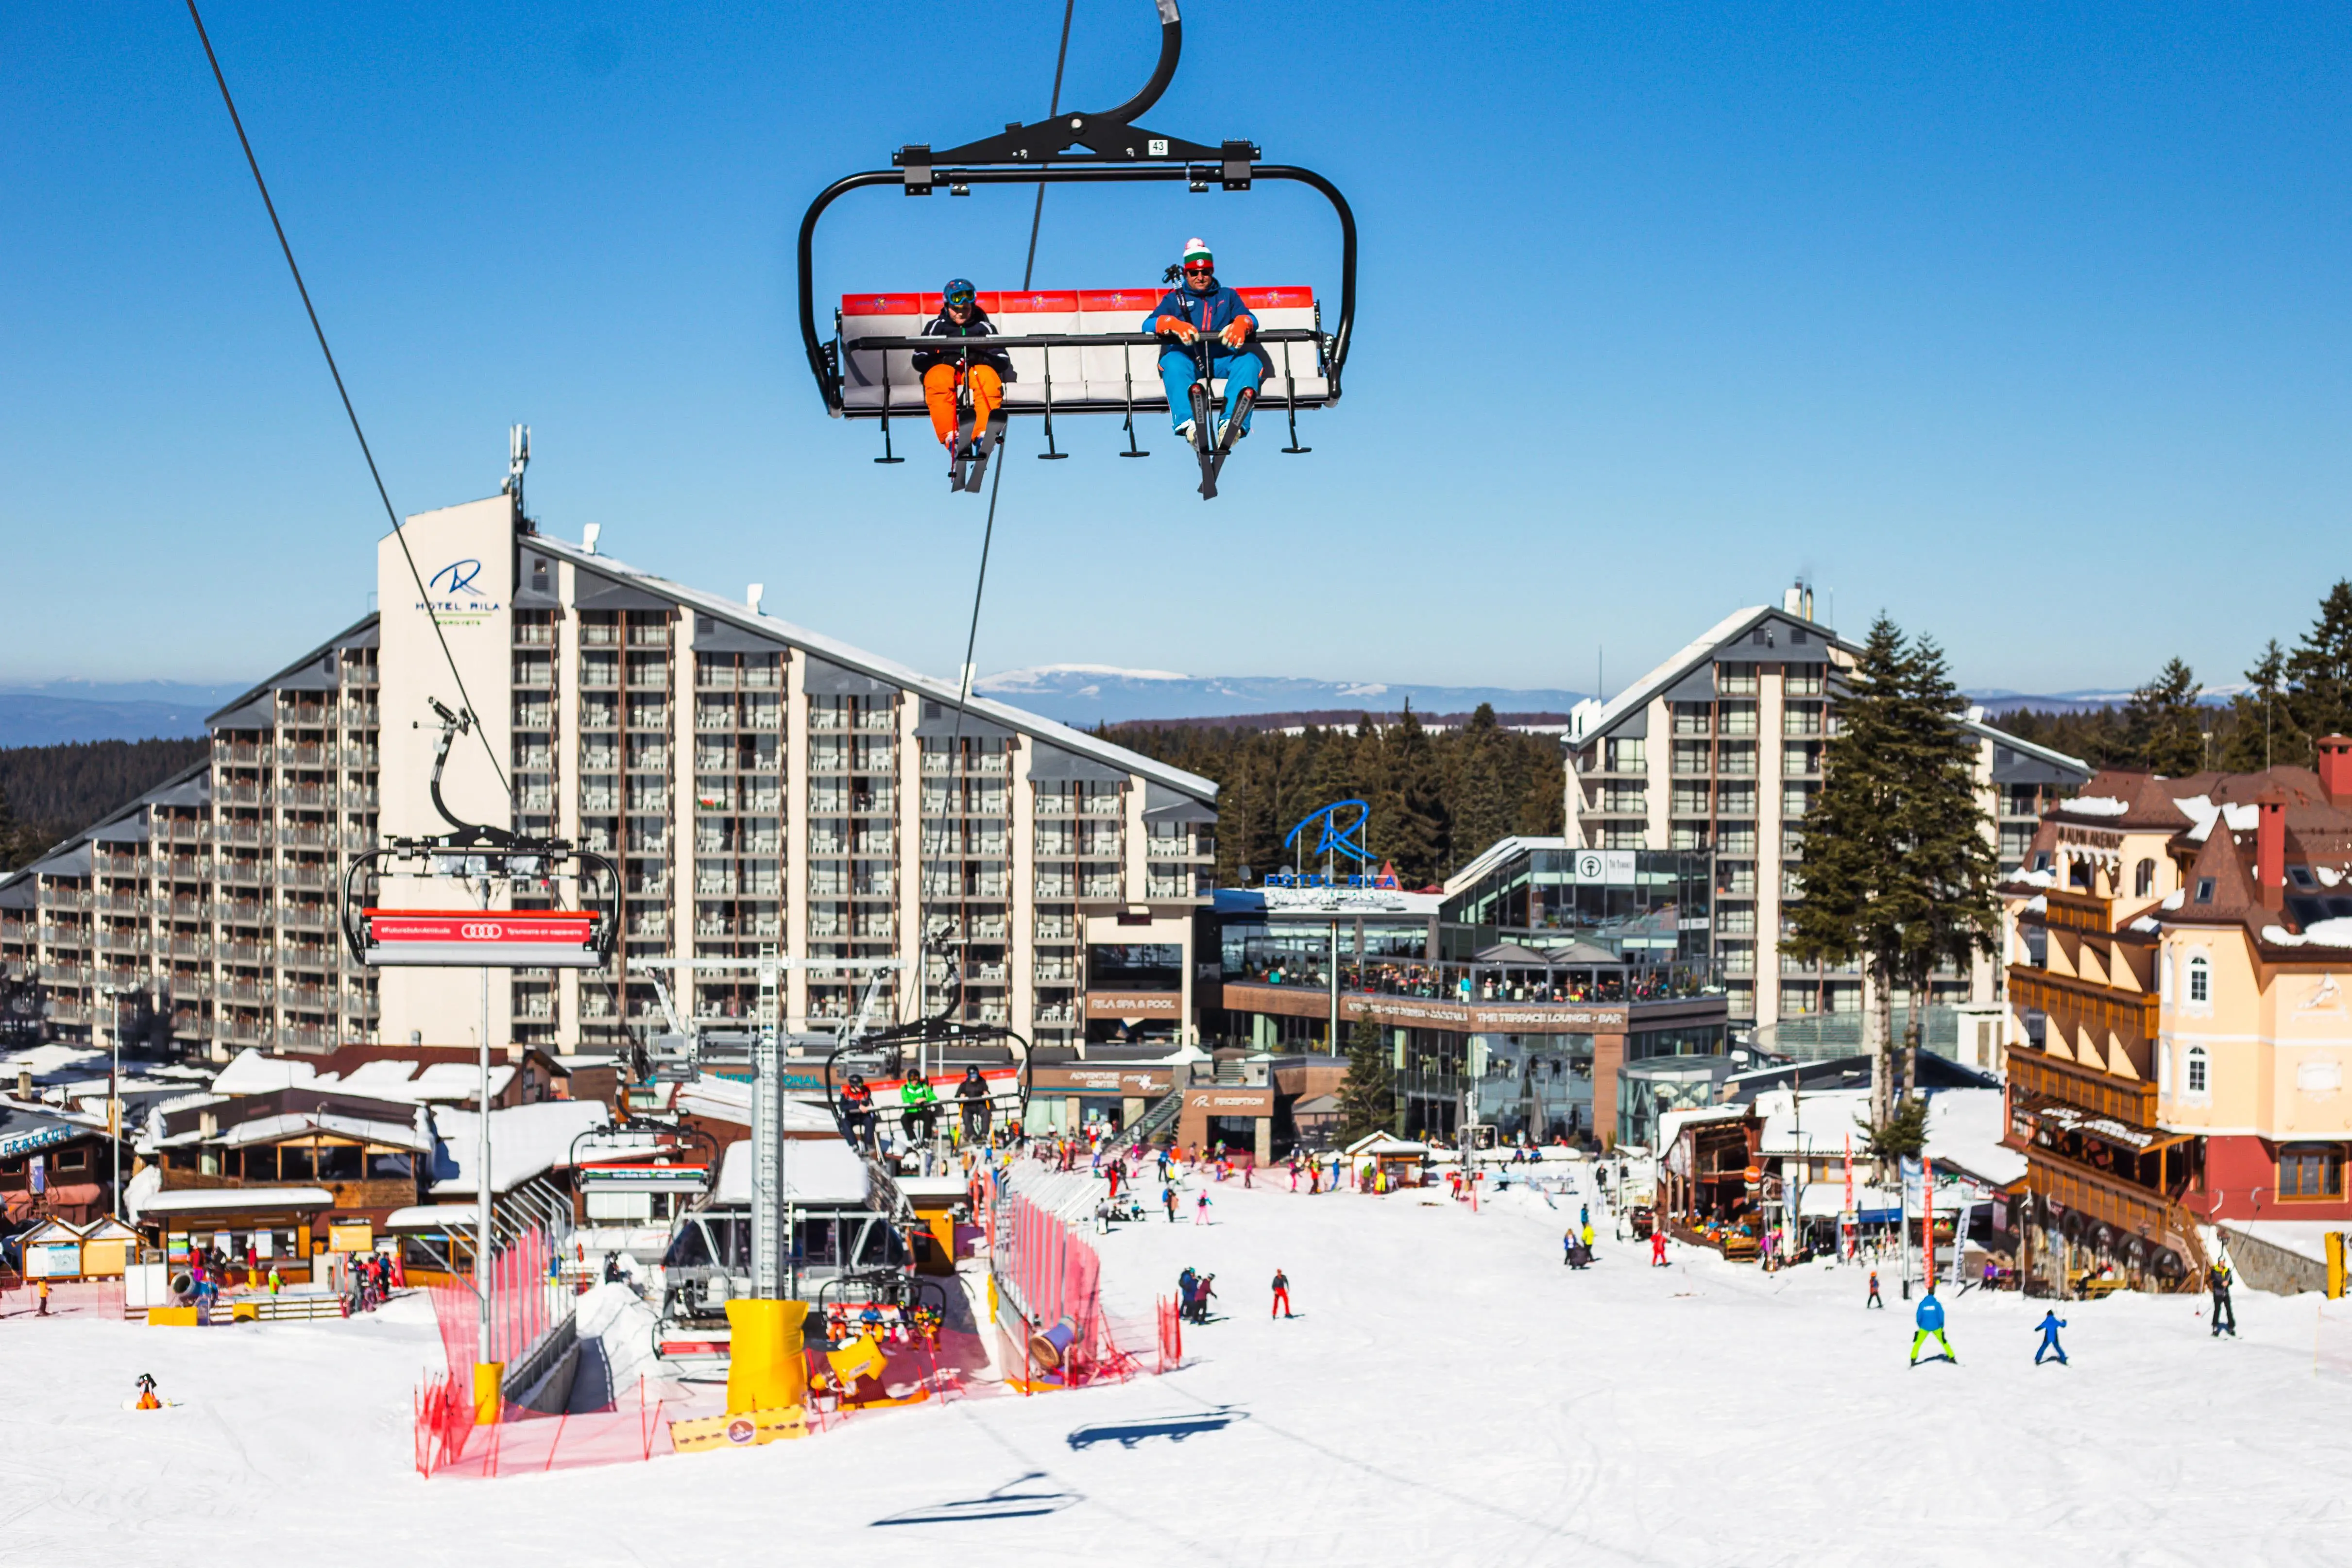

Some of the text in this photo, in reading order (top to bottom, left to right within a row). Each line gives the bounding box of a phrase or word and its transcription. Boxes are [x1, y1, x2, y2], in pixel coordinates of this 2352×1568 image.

[1153, 141, 1164, 151] 43
[416, 602, 500, 611] HOTEL RILA
[1265, 874, 1397, 887] HOTEL RILA
[1146, 999, 1176, 1009] POOL
[1548, 1013, 1591, 1023] LOUNGE
[1598, 1013, 1622, 1023] BAR
